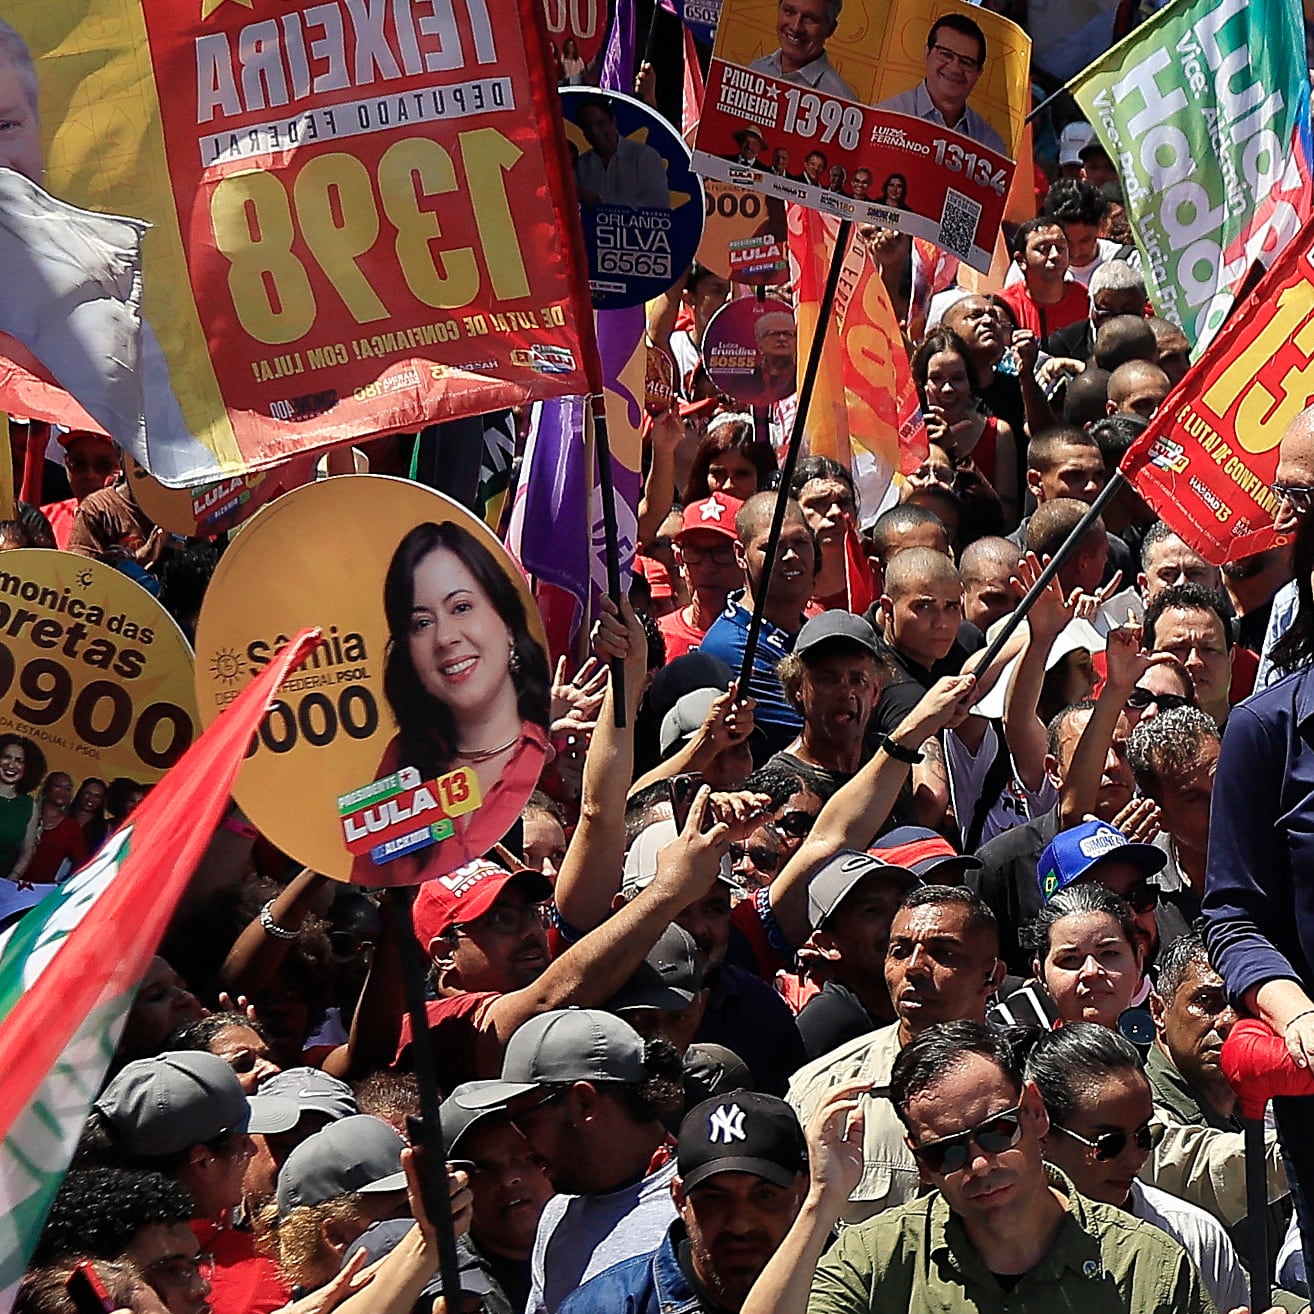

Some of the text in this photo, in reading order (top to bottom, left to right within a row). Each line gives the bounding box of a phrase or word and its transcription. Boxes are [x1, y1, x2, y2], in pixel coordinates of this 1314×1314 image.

[722, 66, 766, 94] PAULO
[720, 83, 779, 120] TEIXEIRA
[782, 86, 864, 151] 1398
[1194, 0, 1286, 204] Lula
[870, 134, 931, 156] FERNANDO
[932, 138, 1008, 197] 13134
[597, 213, 672, 230] ORLANDO
[597, 227, 672, 252] SILVA
[600, 251, 670, 277] 6565
[730, 245, 781, 264] LULA
[1183, 413, 1223, 451] LUTA!
[1211, 440, 1233, 466] DE
[194, 477, 244, 516] LULA
[106, 613, 155, 645] das
[283, 666, 371, 694] FEDERAL PSOL
[242, 684, 379, 760] 000
[343, 771, 469, 843] LULA 13
[709, 1103, 747, 1144] NY
